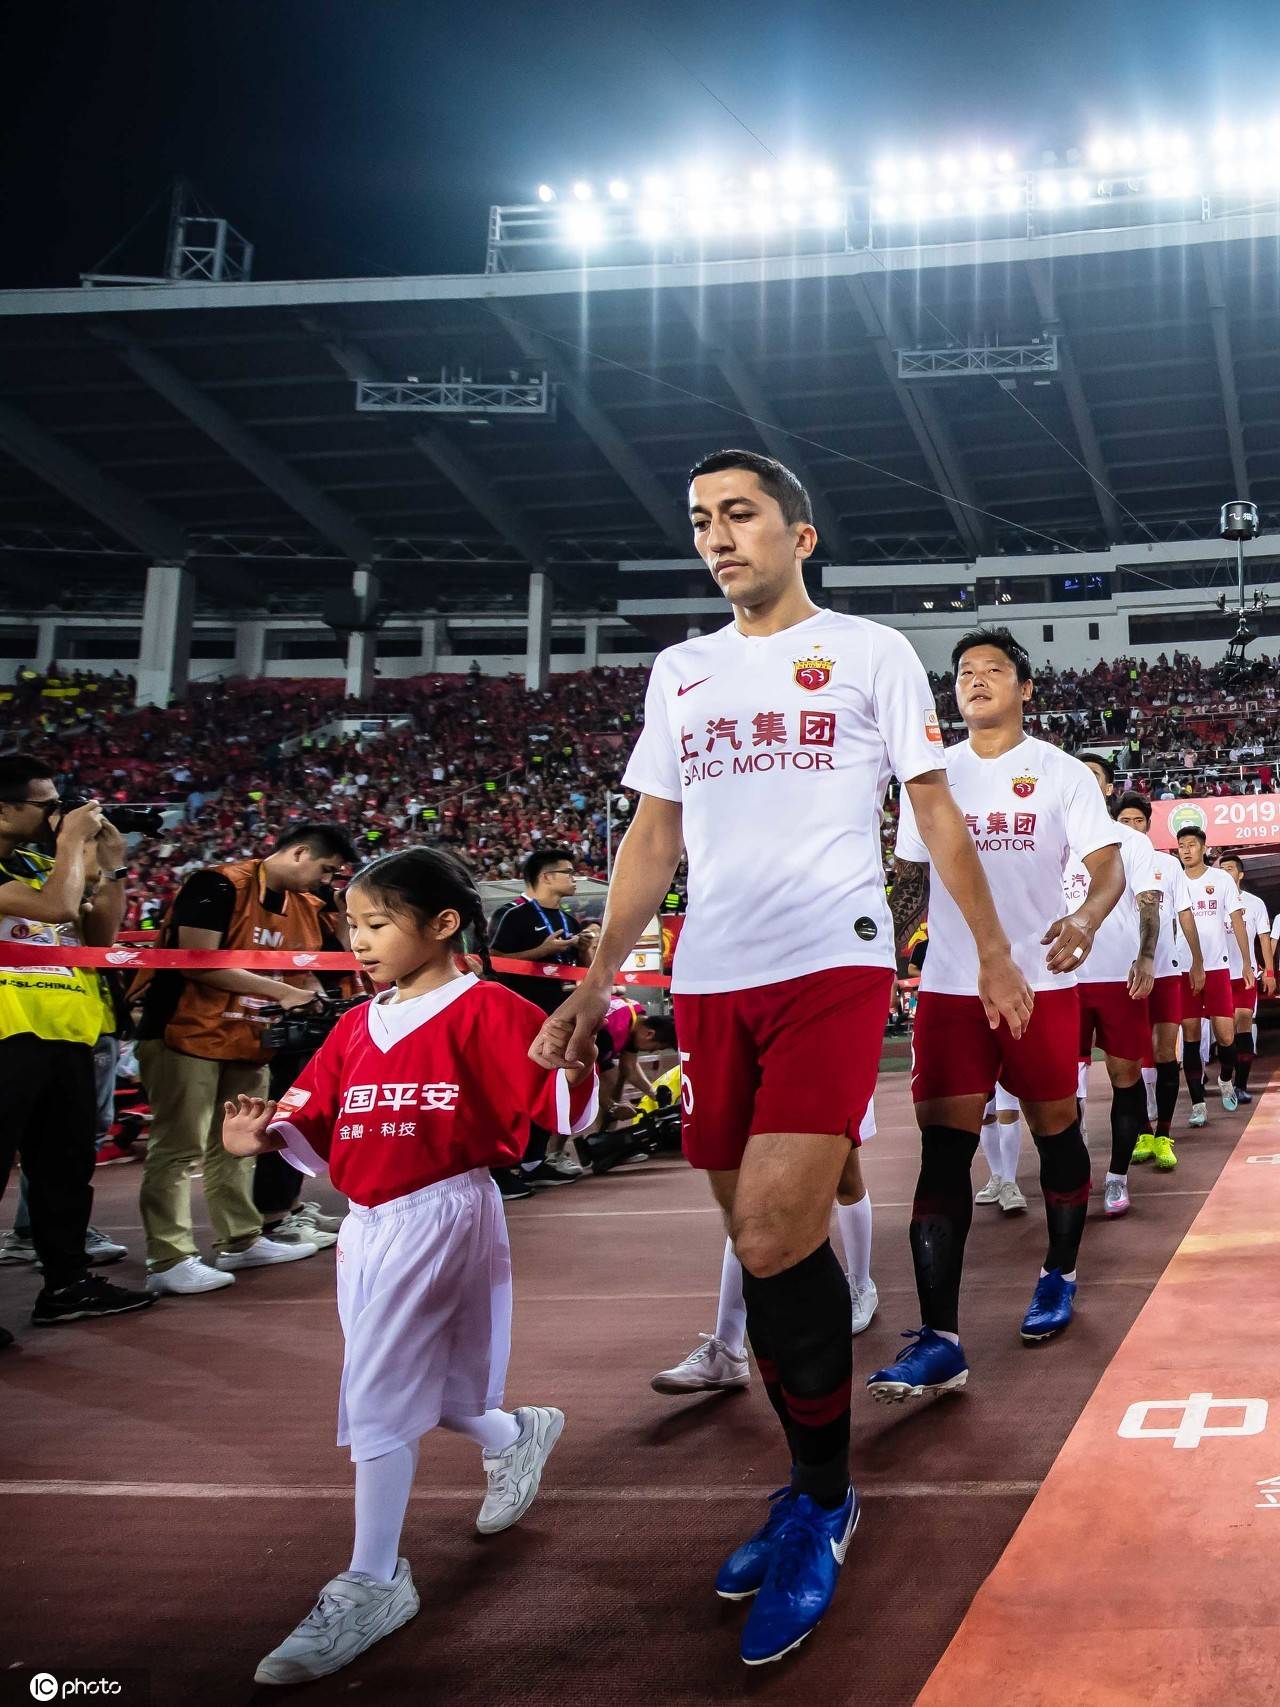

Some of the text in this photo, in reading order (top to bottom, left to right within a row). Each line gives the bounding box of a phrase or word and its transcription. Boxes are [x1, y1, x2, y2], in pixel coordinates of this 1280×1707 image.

[681, 710, 836, 763] 上汽集团
[684, 751, 835, 786] SAIC MOTOR
[975, 838, 1035, 852] MOTOR
[1235, 826, 1267, 840] 2019
[253, 926, 285, 948] EN
[339, 1081, 460, 1118] 国平安
